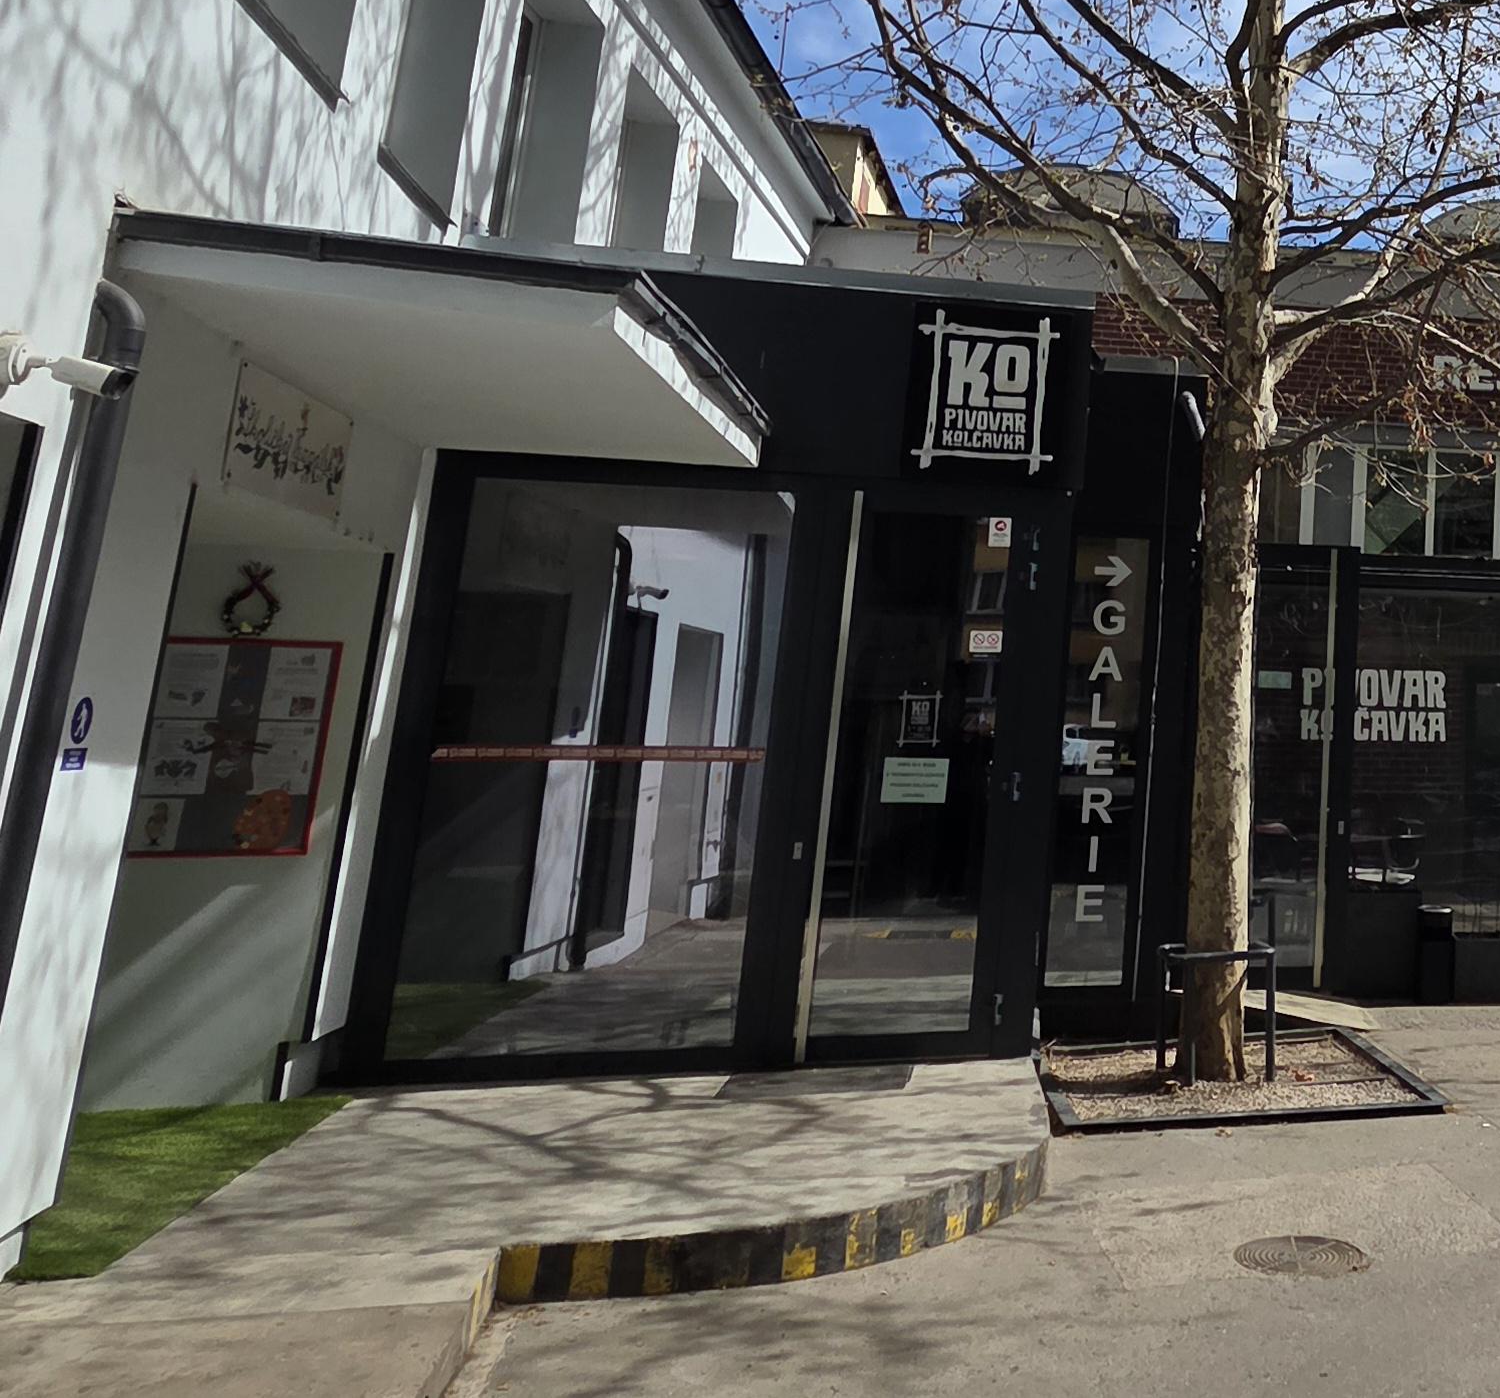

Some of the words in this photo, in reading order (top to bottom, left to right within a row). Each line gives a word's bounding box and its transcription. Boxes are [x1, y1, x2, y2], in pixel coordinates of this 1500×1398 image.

[943, 408, 1027, 433] PIVOVAR
[1302, 667, 1447, 709] PIOVAR
[1300, 706, 1447, 742] KOČAVKA
[1075, 599, 1127, 923] GALERIE
